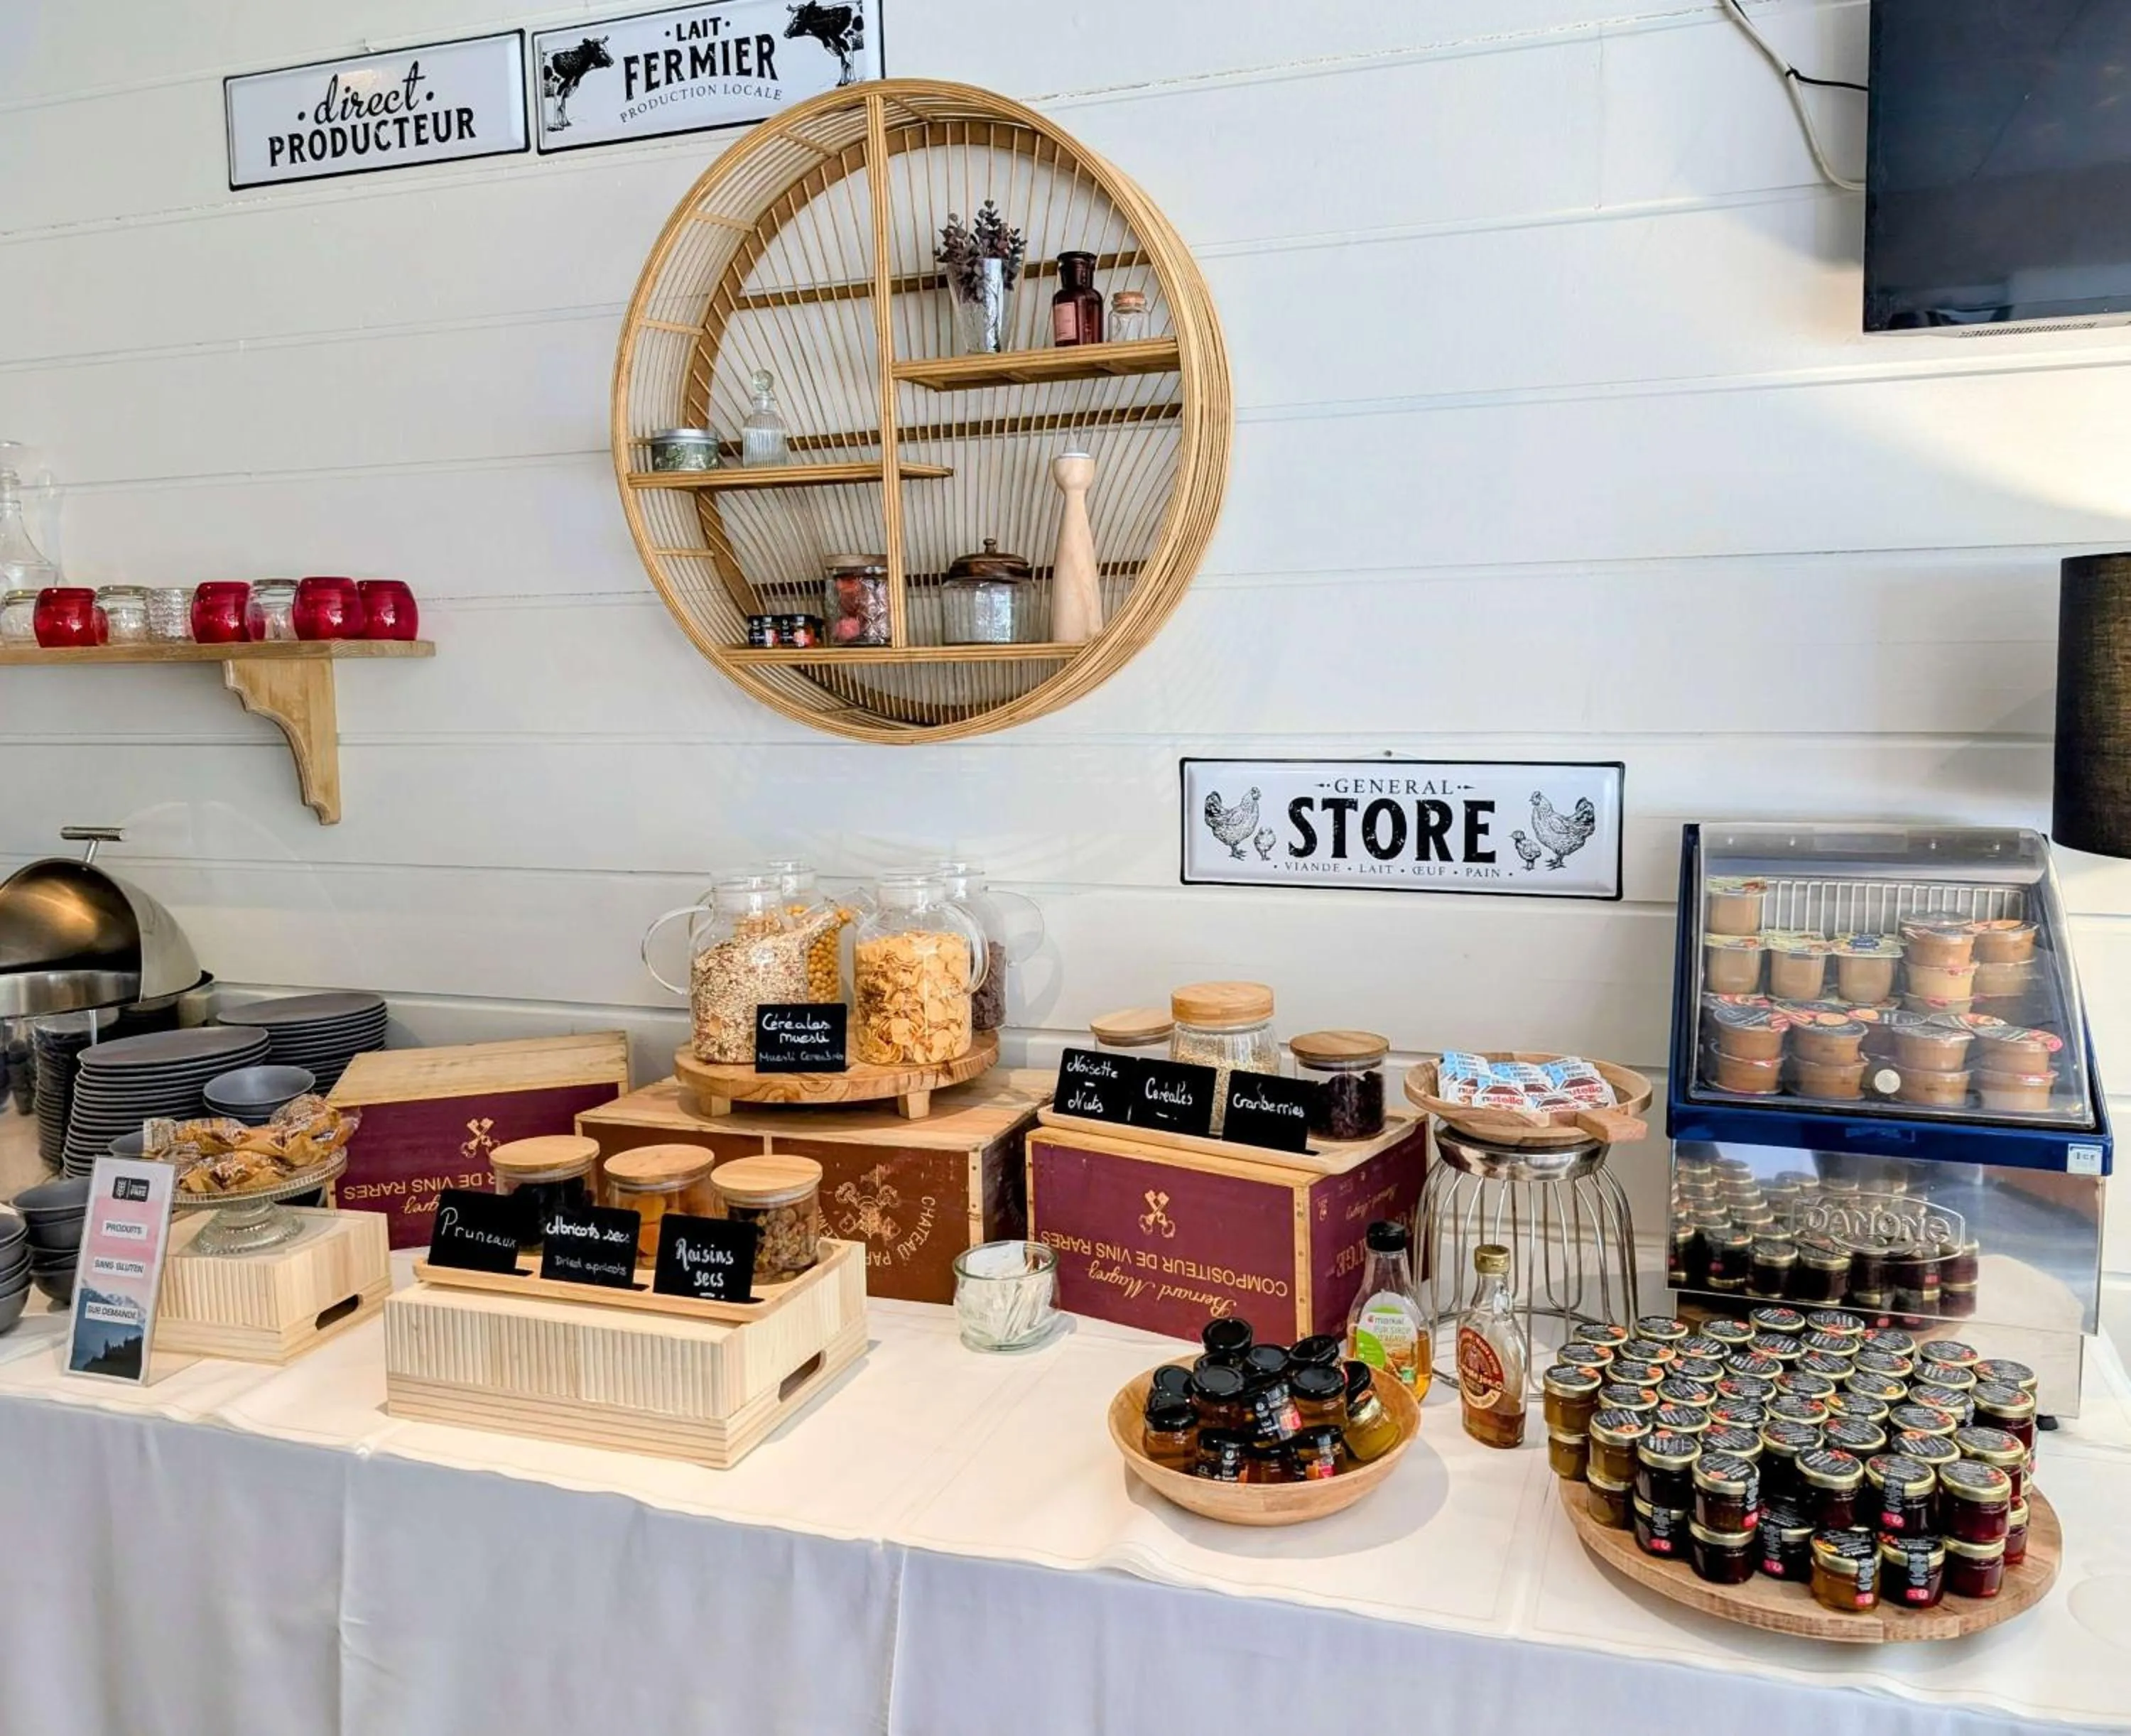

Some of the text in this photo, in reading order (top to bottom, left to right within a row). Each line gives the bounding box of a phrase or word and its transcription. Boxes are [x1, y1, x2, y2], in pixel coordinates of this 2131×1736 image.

[676, 17, 721, 41] LAIT
[624, 34, 779, 102] FERMIER
[314, 60, 426, 125] direct
[620, 83, 782, 123] PRODUCTION LOCALE
[268, 107, 477, 167] PRODUCTEUR
[1335, 779, 1454, 795] GENERAL
[1288, 796, 1496, 863] STORE
[1285, 862, 1340, 873] VIANDE
[1360, 864, 1393, 874] LAIT
[1465, 867, 1501, 877] PAIN
[1067, 1054, 1118, 1078] Noisette
[1068, 1090, 1104, 1113] Nuts
[1232, 1092, 1305, 1118] Cranberries
[1482, 1096, 1524, 1106] nutella
[343, 1179, 406, 1200] RARES
[412, 1174, 454, 1193] VINS
[460, 1173, 482, 1188] DE
[440, 1207, 516, 1248] Pruneaux
[897, 1196, 936, 1260] CHATEAU
[676, 1237, 734, 1271] Raisins
[1041, 1230, 1288, 1298] COMPOSITEUR DE VINS RARES
[693, 1270, 724, 1287] secs
[1157, 1284, 1237, 1318] Bernard
